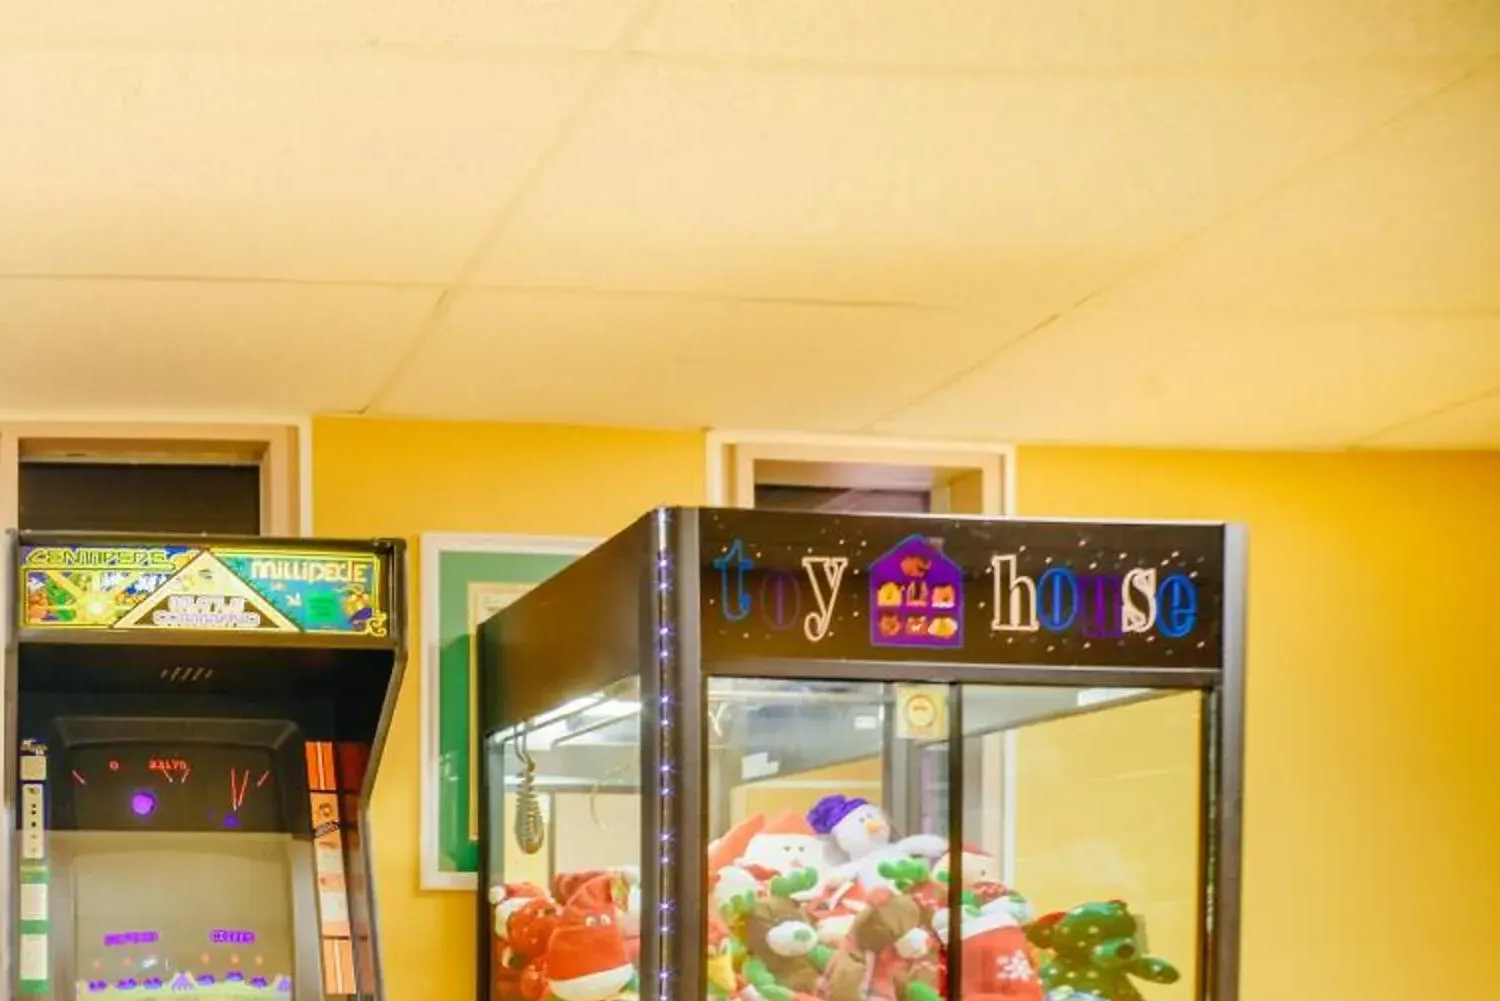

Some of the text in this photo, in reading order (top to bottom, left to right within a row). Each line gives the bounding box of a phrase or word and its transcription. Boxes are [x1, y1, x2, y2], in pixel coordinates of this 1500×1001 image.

[26, 547, 168, 566] CENTIPEDE
[713, 537, 1198, 642] toy house
